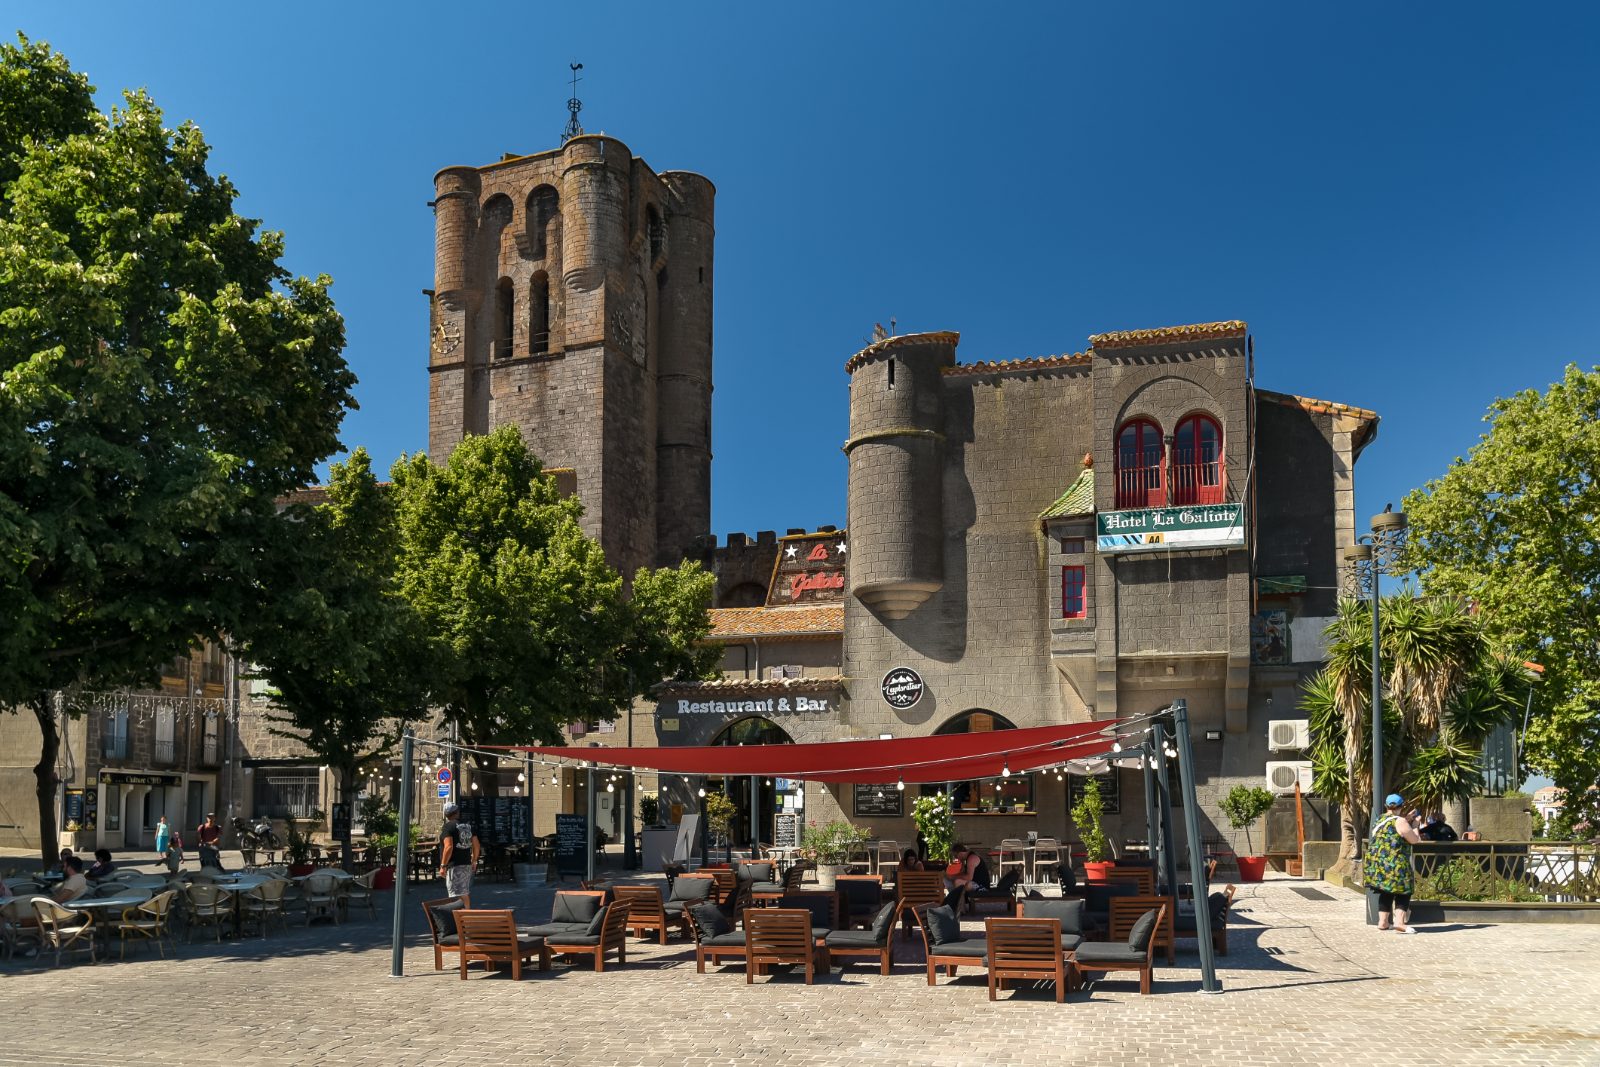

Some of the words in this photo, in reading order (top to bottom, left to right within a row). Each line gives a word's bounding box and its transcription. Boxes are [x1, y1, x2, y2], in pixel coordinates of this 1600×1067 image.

[1105, 513, 1146, 530] Hotel
[1152, 512, 1174, 529] La
[1179, 510, 1235, 524] Galiote
[807, 544, 829, 560] La
[791, 572, 845, 600] Galiote
[677, 699, 774, 714] Restaurant
[777, 697, 792, 712] &
[795, 696, 828, 712] Bar
